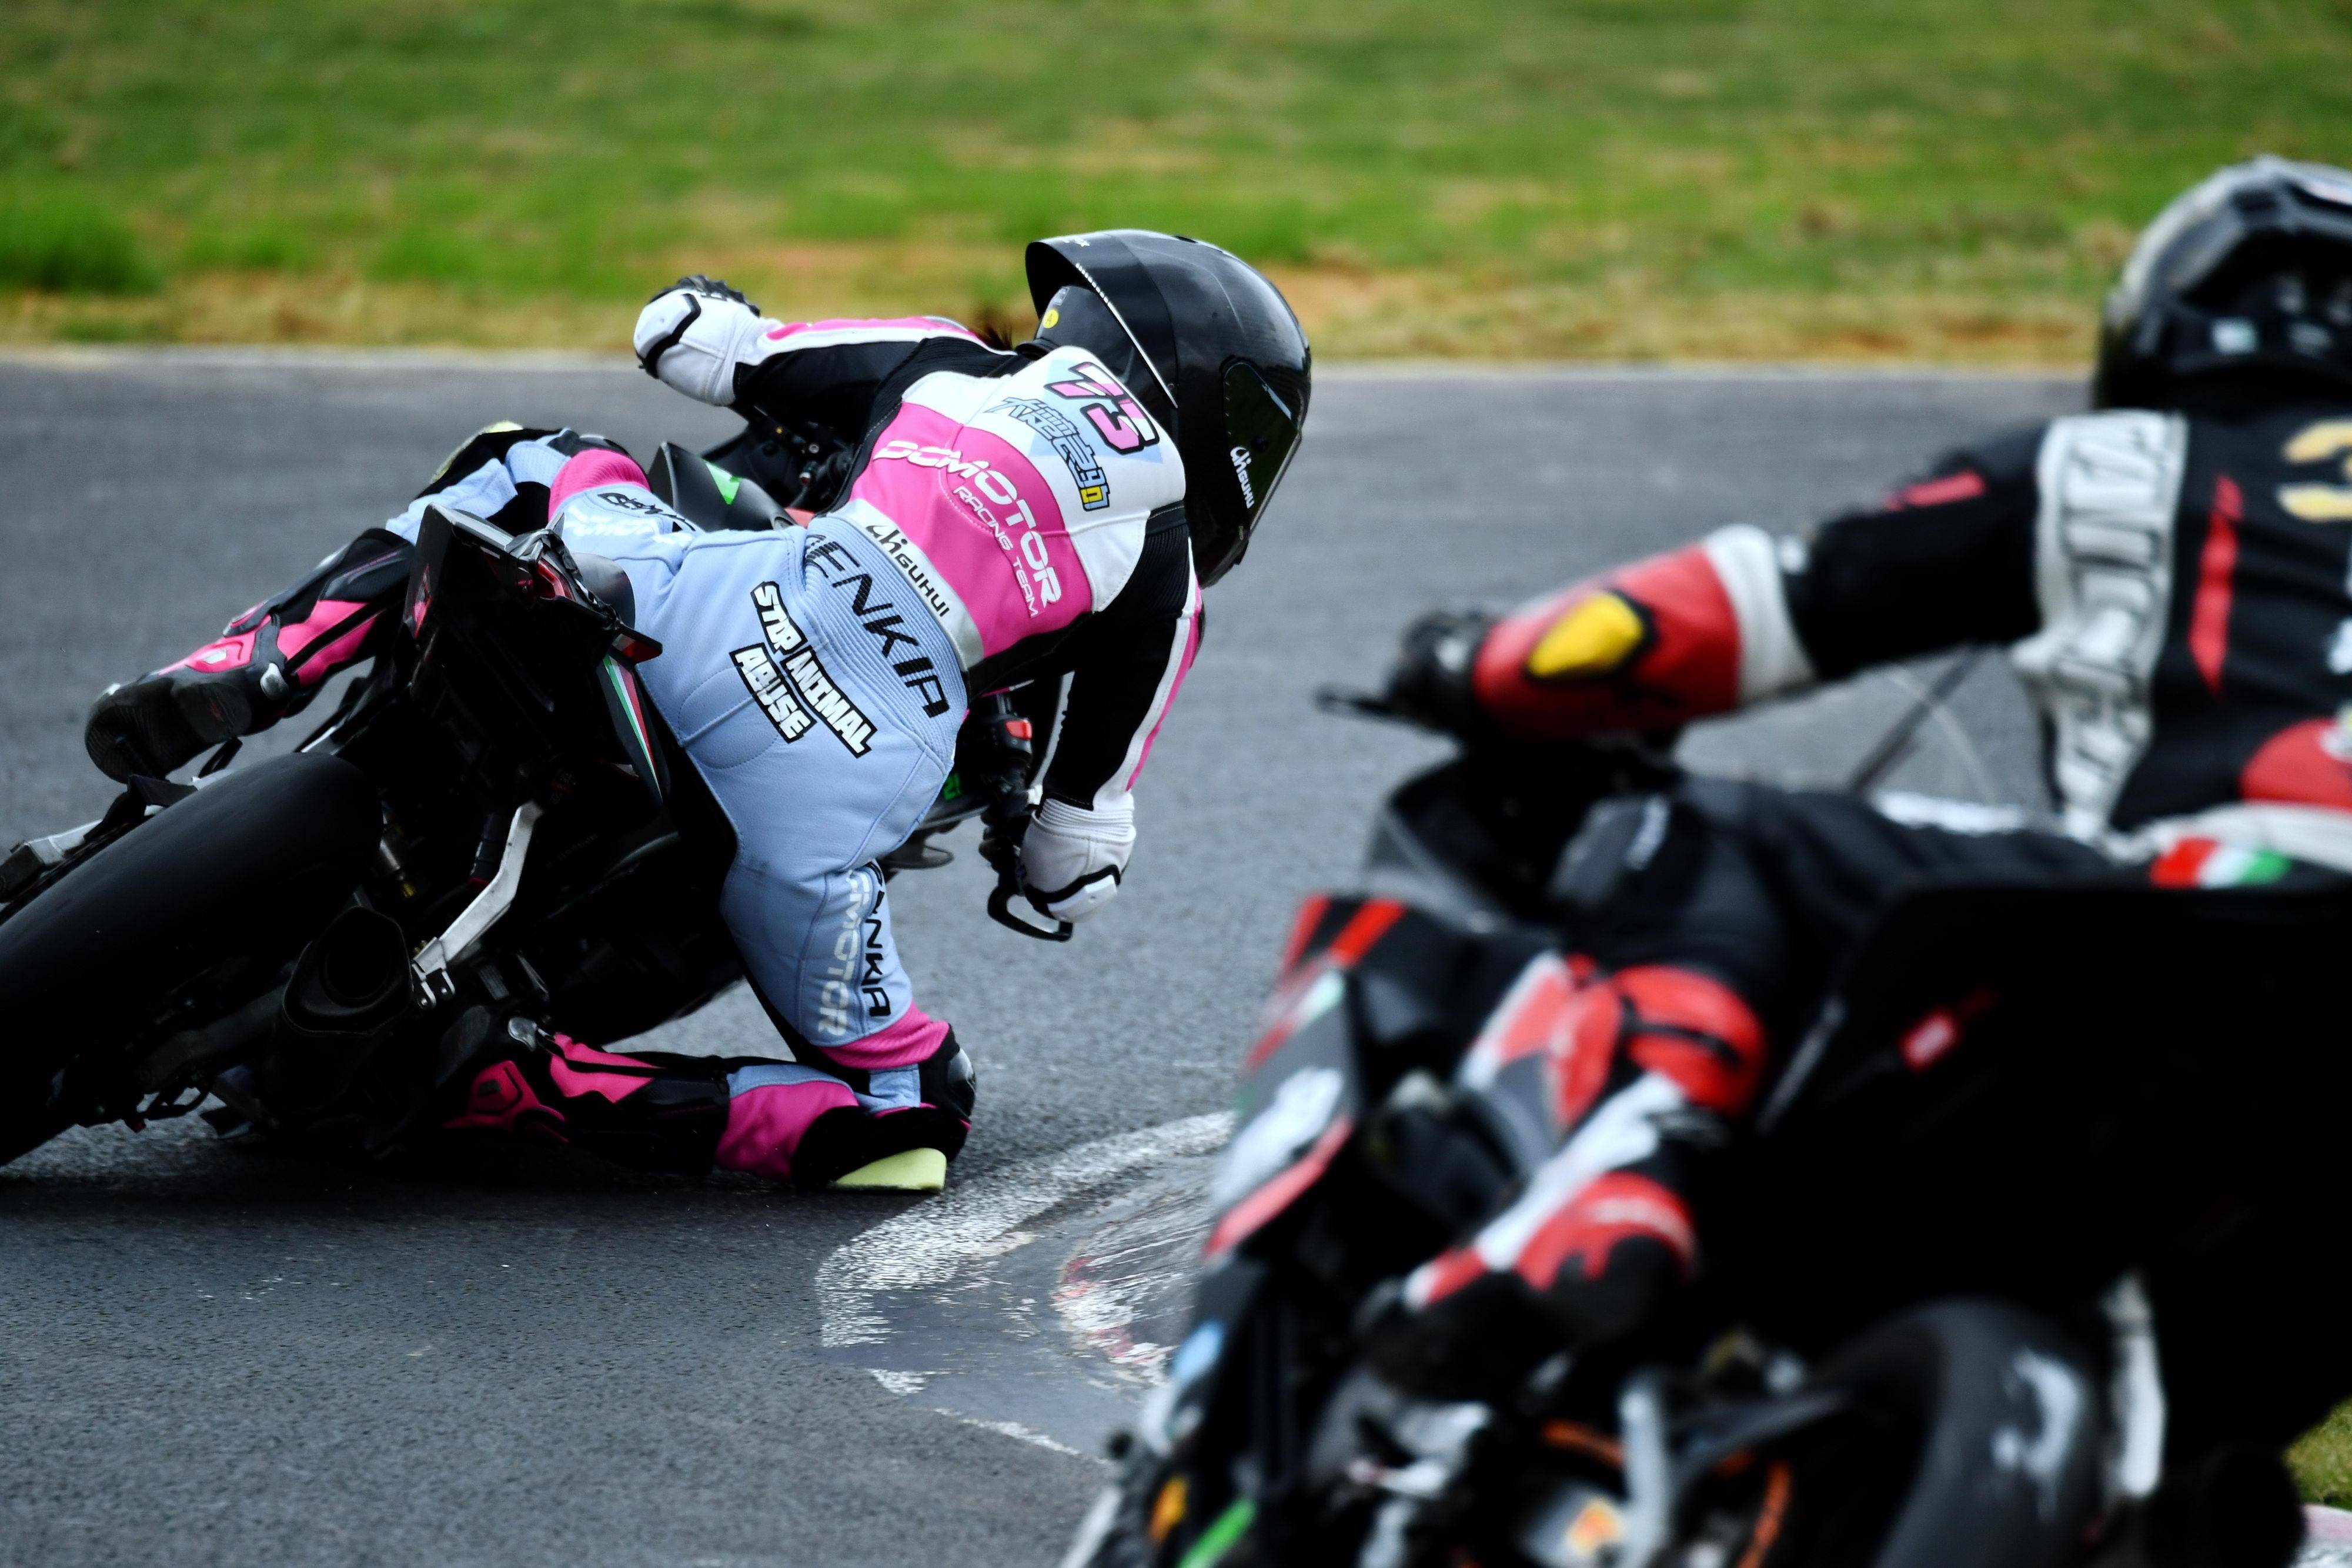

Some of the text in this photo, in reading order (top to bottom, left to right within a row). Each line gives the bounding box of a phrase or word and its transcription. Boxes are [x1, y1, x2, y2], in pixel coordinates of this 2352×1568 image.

[1044, 361, 1160, 455] 73
[953, 486, 1039, 618] RACING TEAM
[752, 583, 874, 755] STOP ANIMAL
[804, 534, 950, 718] ENKIA
[733, 645, 814, 741] ABUSE
